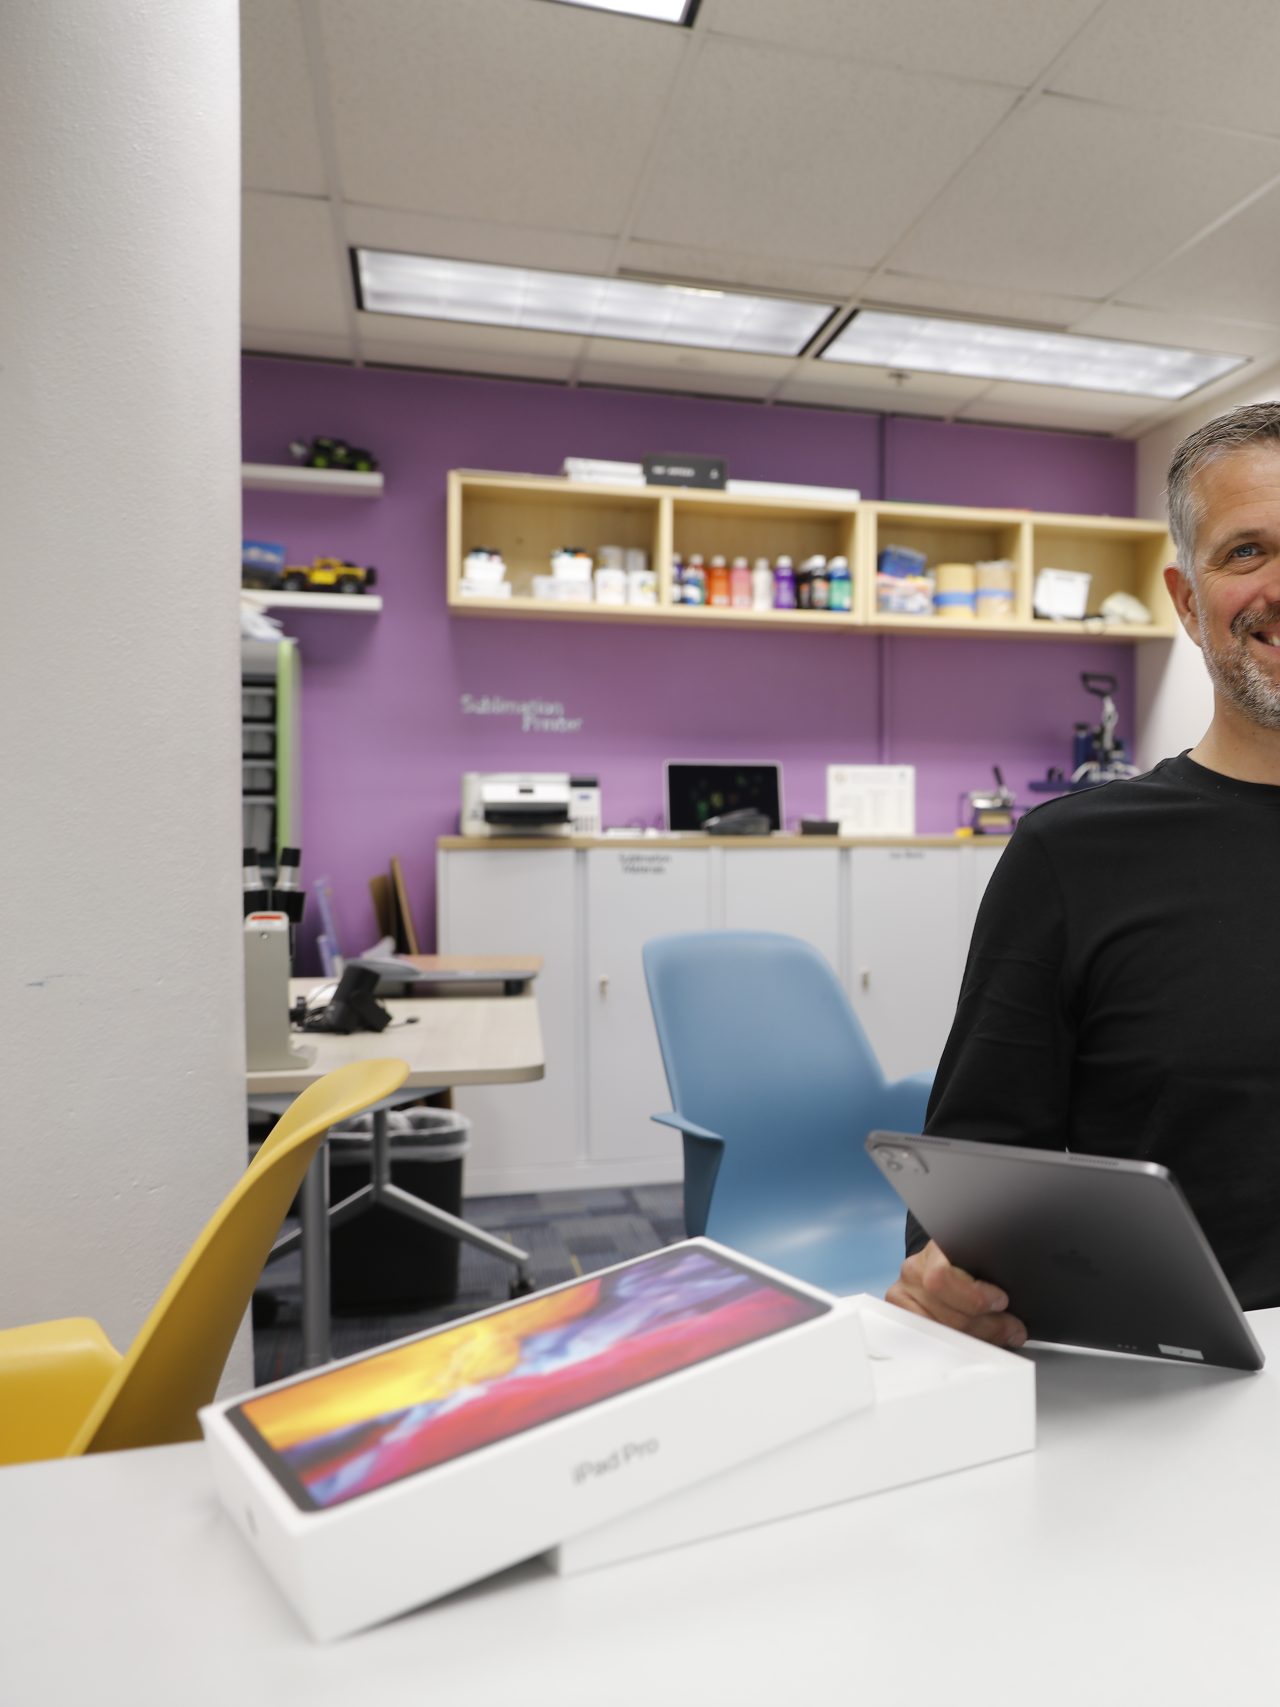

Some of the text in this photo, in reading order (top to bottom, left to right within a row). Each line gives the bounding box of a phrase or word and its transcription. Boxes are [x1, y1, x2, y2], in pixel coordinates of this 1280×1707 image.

[461, 693, 565, 715] Sublimation
[522, 712, 583, 733] Printer
[573, 1438, 660, 1485] iPad Pro
